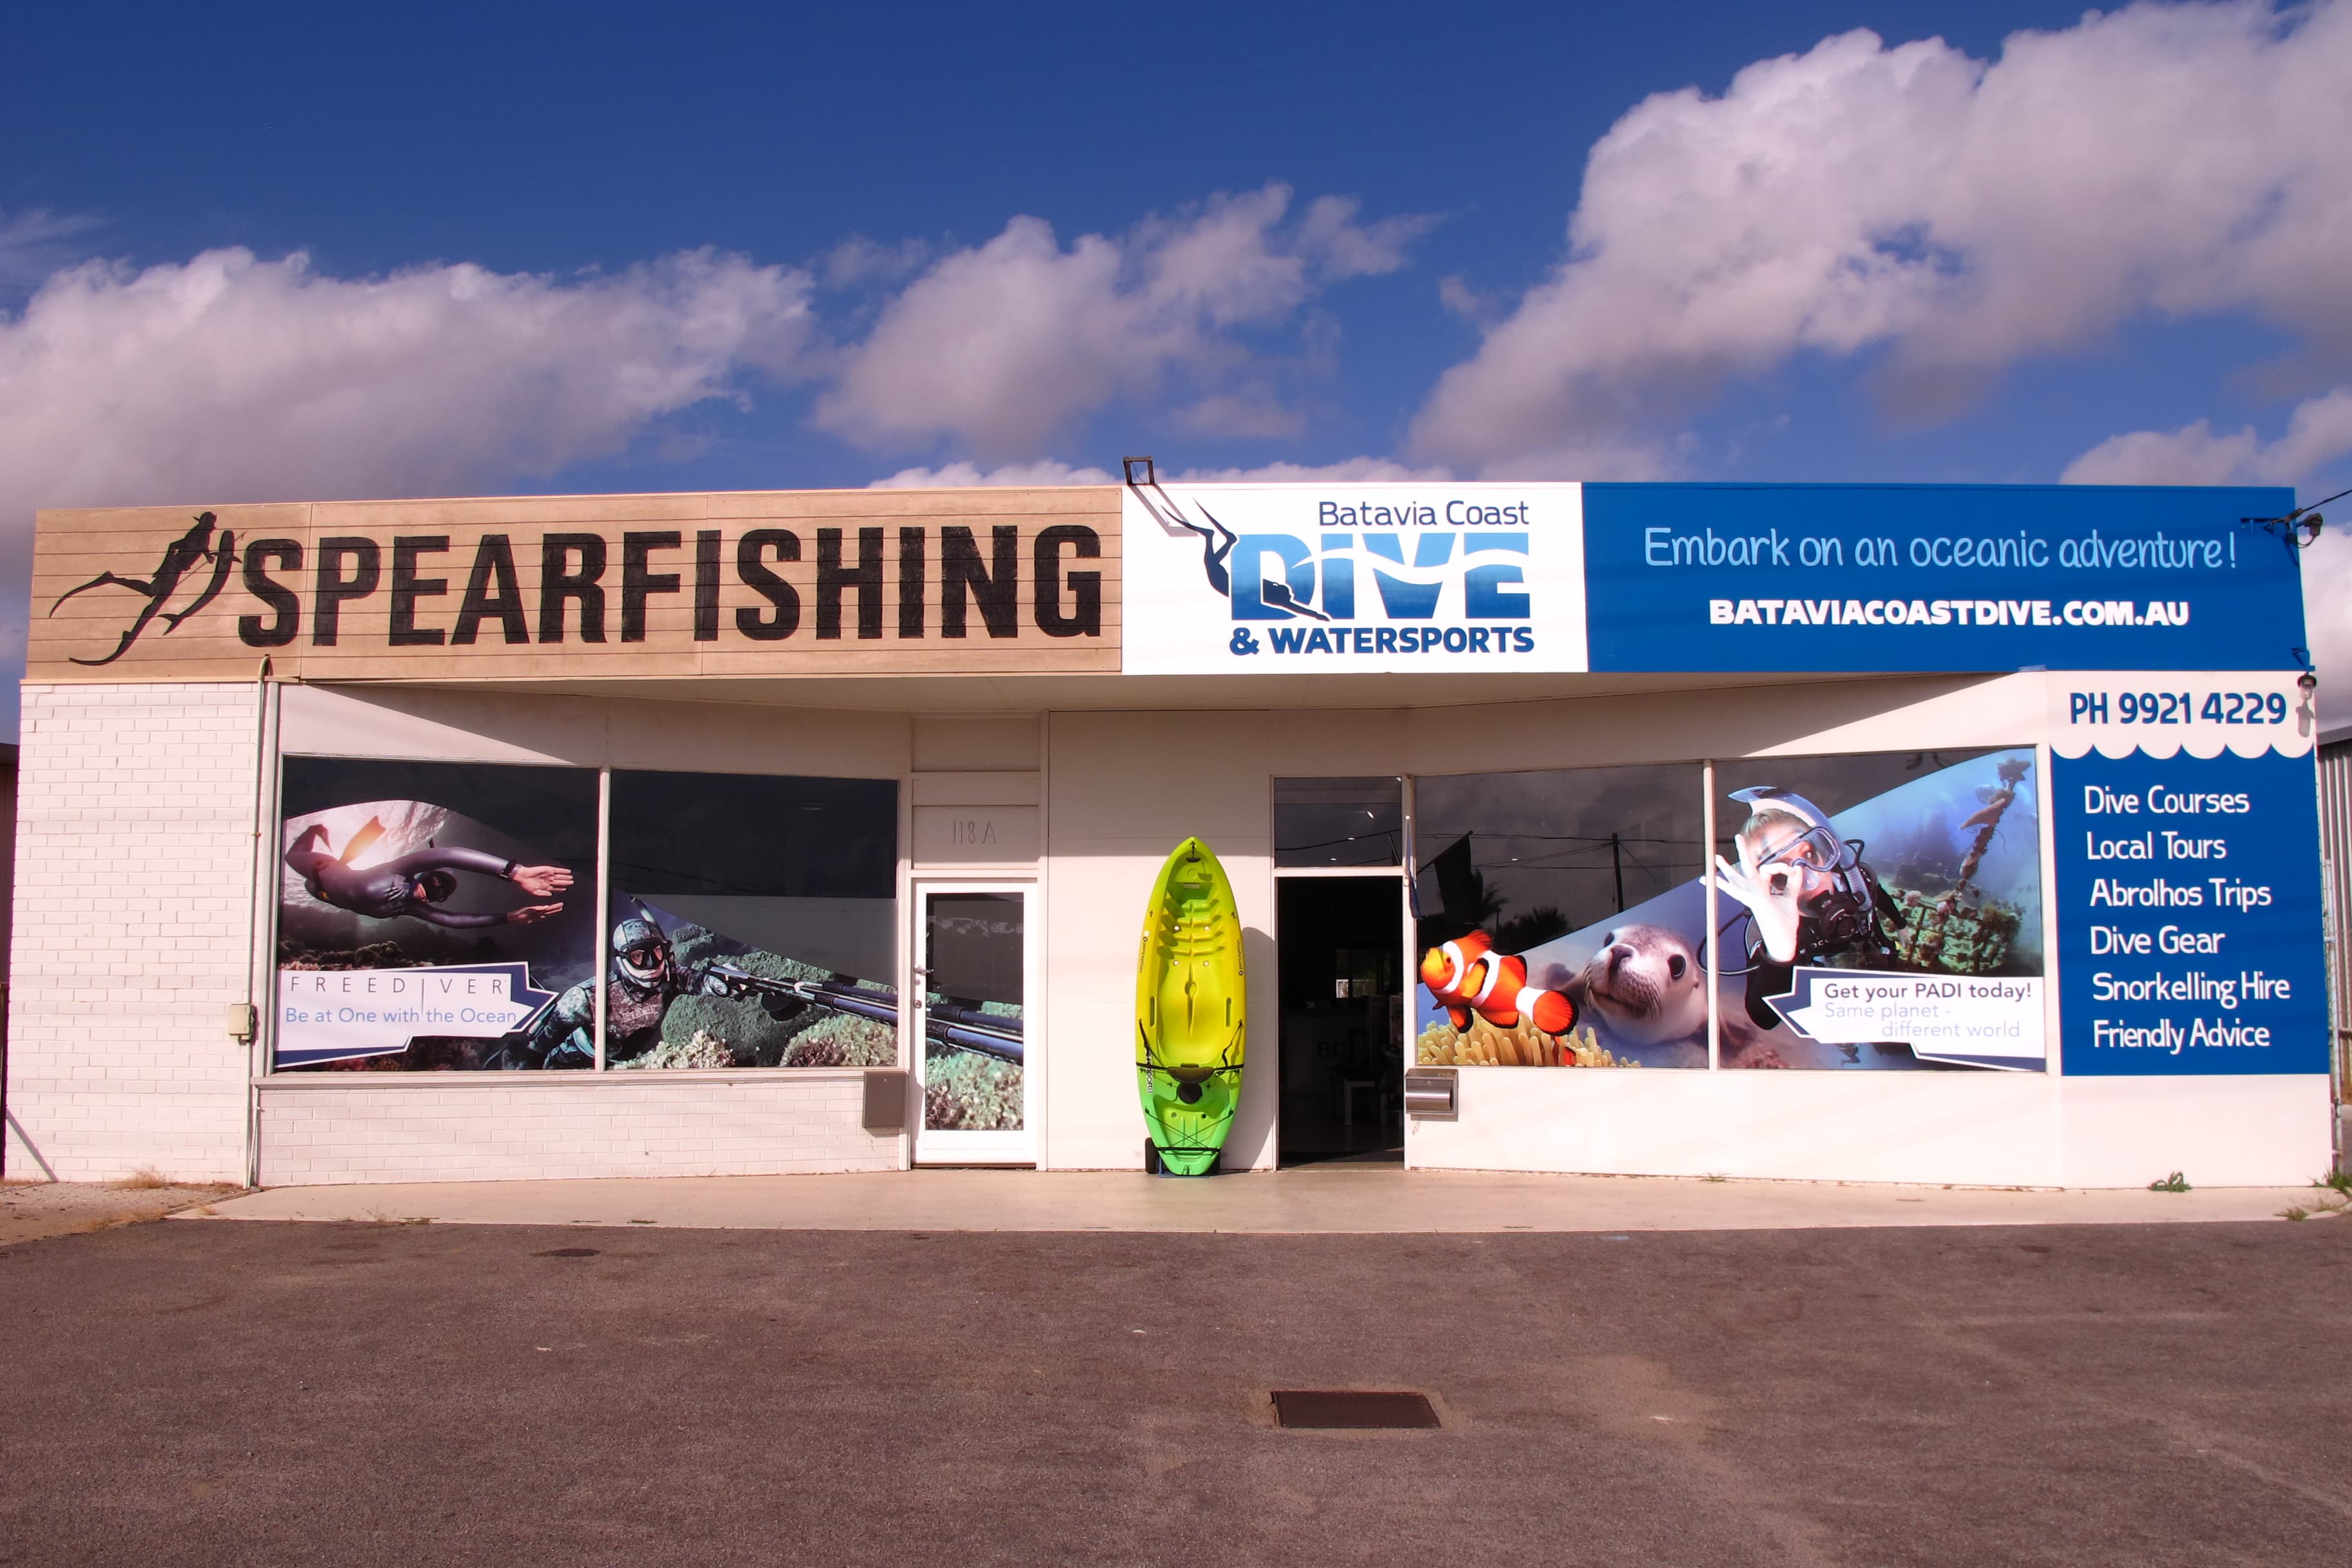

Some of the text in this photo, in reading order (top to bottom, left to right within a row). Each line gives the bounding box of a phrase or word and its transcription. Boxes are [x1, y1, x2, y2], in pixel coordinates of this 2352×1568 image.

[1320, 500, 1529, 525] Batavia Coast
[1645, 527, 2235, 568] Embark on an oceanic adventure!
[238, 524, 1101, 647] SPEARFISHING
[1231, 533, 1531, 620] DIVE
[1710, 600, 2188, 625] BATAVIACOASTDIVE.COM.AU
[1230, 627, 1534, 655] & WATERSPORTS
[2071, 692, 2286, 724] PH 9921 4229
[2085, 785, 2250, 813] Dive Courses
[2088, 831, 2226, 859] Local Tours
[2090, 878, 2271, 912] Abrolhos Trips
[2091, 925, 2225, 954] Dive Gear
[1825, 982, 2030, 1003] Get your PADI today!
[2093, 972, 2290, 1009] Snorkelling Hire
[286, 1008, 516, 1023] Be at One with the Ocean
[1825, 1002, 1874, 1017] Same
[1882, 1003, 1938, 1021] planet
[1882, 1021, 2019, 1037] different world
[2094, 1018, 2269, 1054] Friendly Advice
